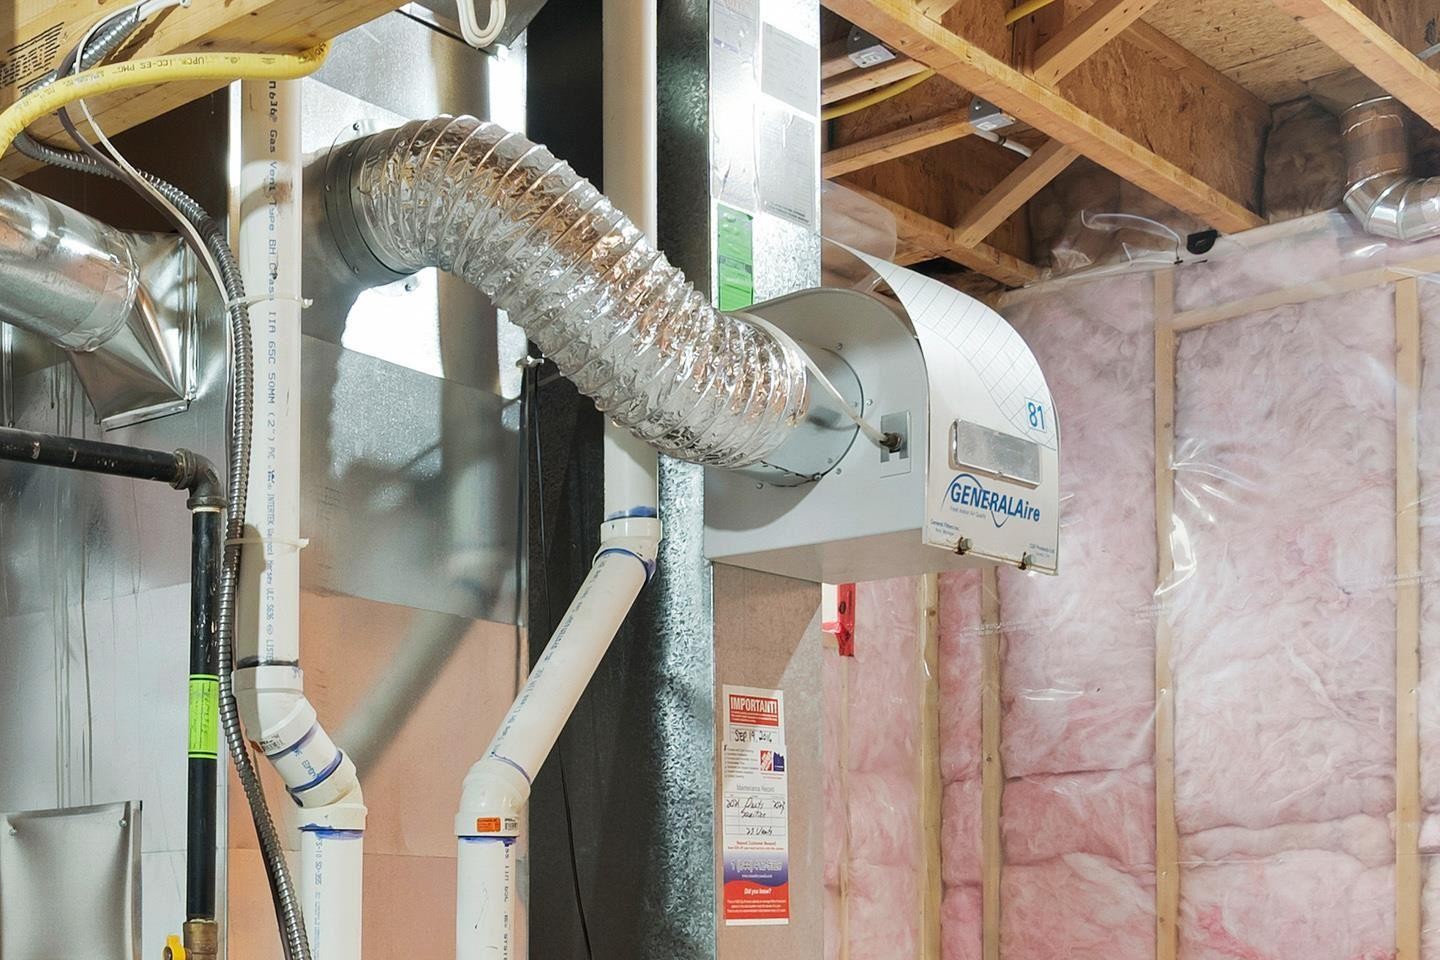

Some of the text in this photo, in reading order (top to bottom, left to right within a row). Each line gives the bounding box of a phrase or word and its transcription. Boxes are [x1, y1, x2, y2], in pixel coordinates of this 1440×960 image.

[268, 129, 277, 153] Gas
[268, 161, 277, 191] Vent
[267, 200, 277, 231] Type
[268, 239, 277, 255] BH
[268, 341, 277, 364] 65C
[268, 372, 276, 404] 50MM
[1026, 401, 1046, 430] 81
[266, 493, 276, 525] INTERTEK
[950, 481, 1041, 523] GENERALAire
